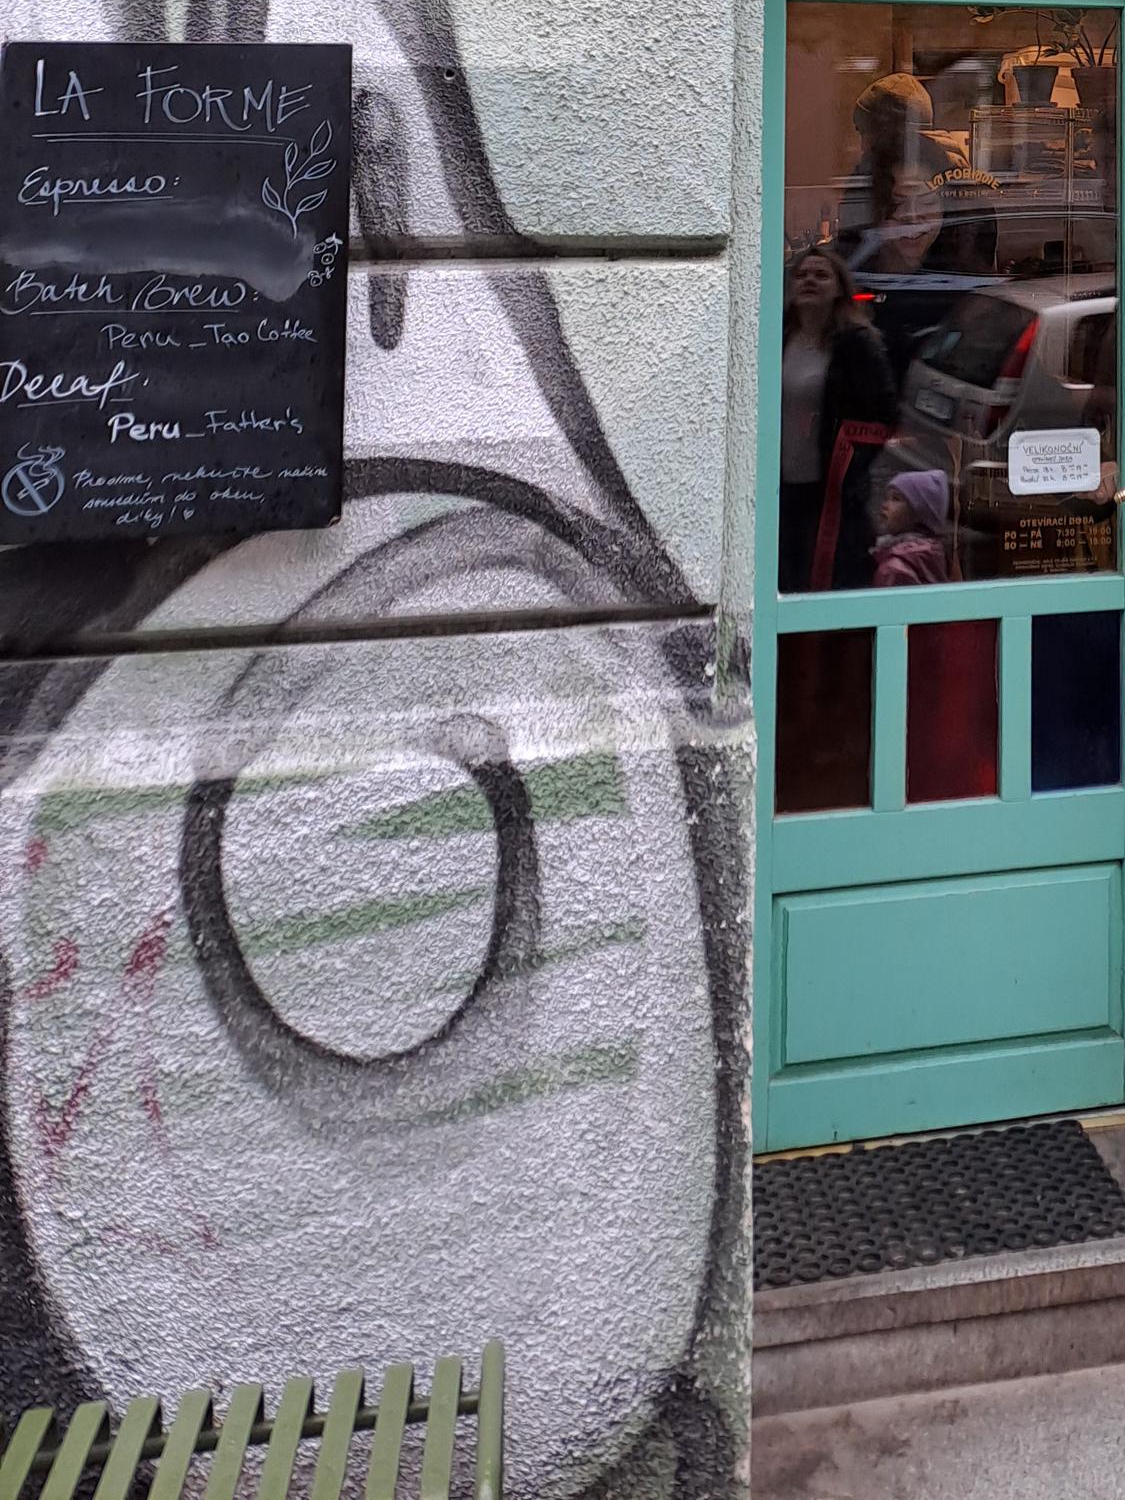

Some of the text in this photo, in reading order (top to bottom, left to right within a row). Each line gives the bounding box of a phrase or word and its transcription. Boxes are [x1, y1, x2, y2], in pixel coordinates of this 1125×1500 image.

[34, 58, 313, 133] LA FORME
[17, 166, 181, 217] Espresso:
[0, 269, 123, 316] Batch
[100, 323, 181, 350] Peru
[256, 318, 320, 344] Coffee
[107, 412, 180, 445] Peru
